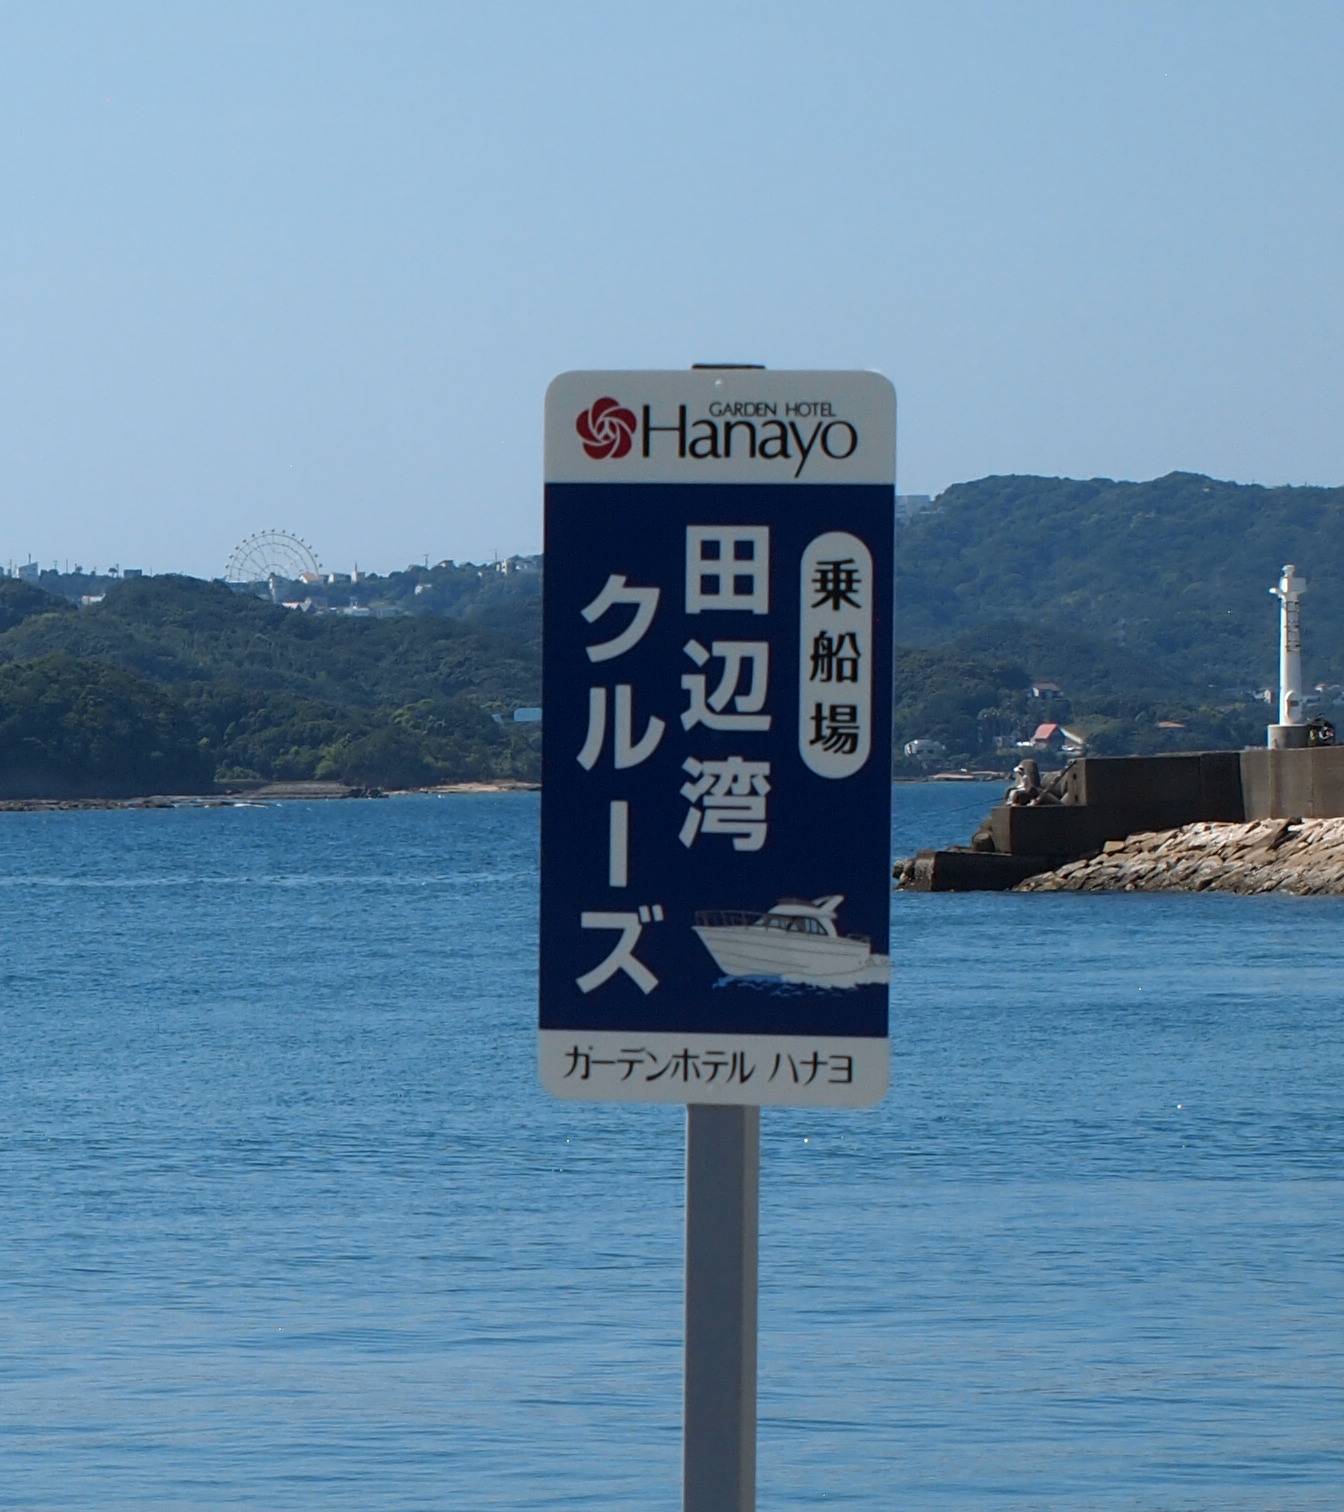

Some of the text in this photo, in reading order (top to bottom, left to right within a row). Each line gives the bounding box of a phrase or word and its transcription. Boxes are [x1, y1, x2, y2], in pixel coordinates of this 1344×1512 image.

[642, 404, 859, 479] Hanayo
[709, 401, 837, 418] GARDEN HOTEL
[678, 525, 772, 852] 田辺湾
[809, 557, 862, 755] 乗船場
[575, 573, 666, 995] クルーズ
[562, 1044, 853, 1086] ガーデンホテル ハナヨ
